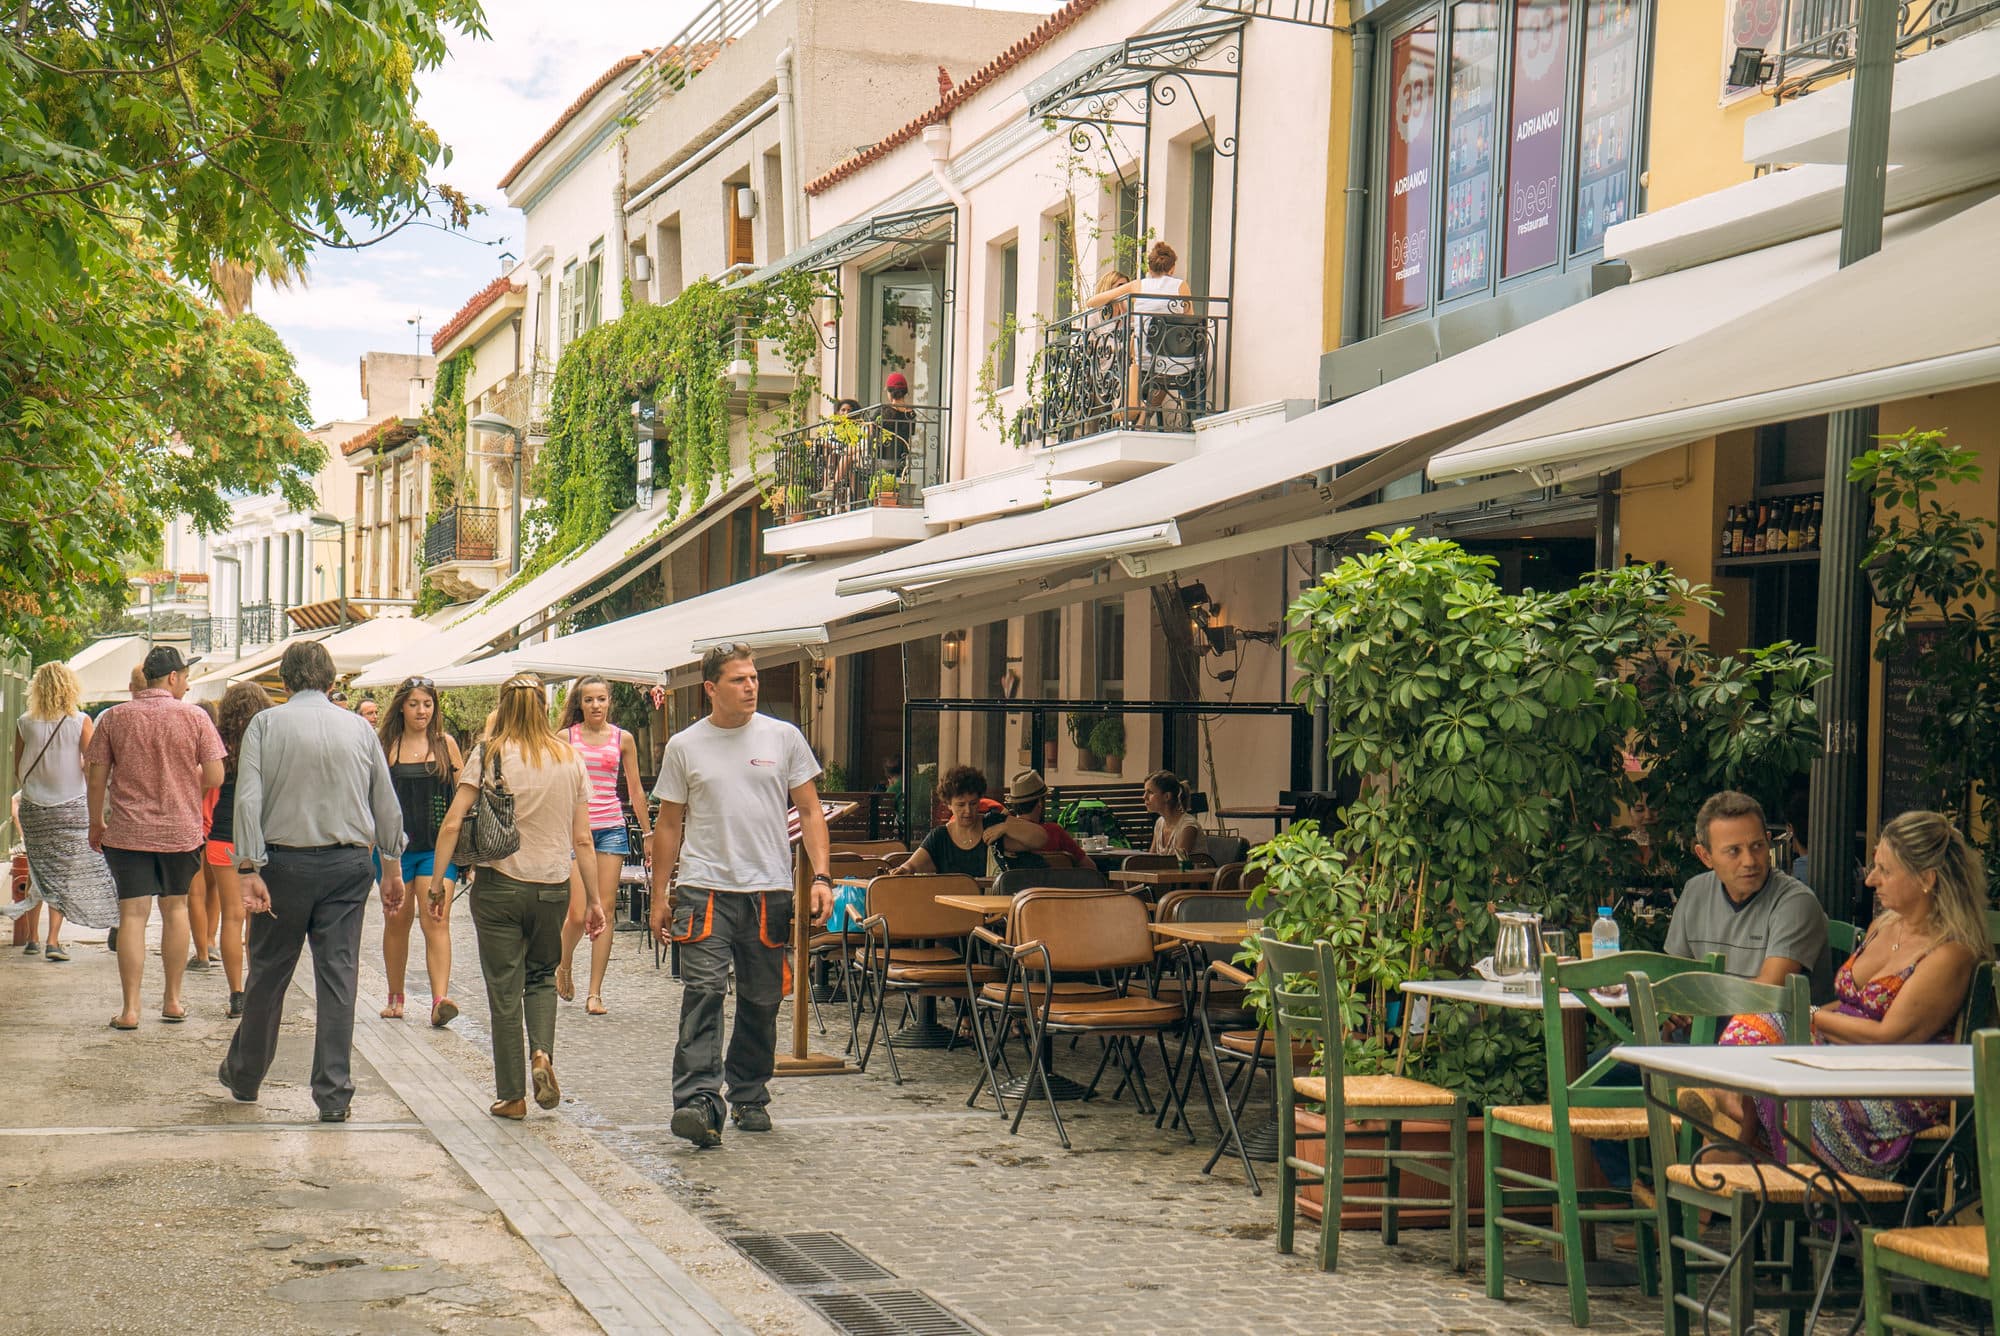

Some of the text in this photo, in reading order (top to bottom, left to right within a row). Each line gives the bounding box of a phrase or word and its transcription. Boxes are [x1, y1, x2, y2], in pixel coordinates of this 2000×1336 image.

[1401, 79, 1424, 124] 33
[1516, 107, 1560, 142] ADRIANOU
[1393, 168, 1428, 197] ADRIANOU
[1513, 176, 1557, 222] beer
[1517, 213, 1549, 235] restaurant
[1392, 229, 1427, 269] beer
[1395, 262, 1421, 281] restaurant
